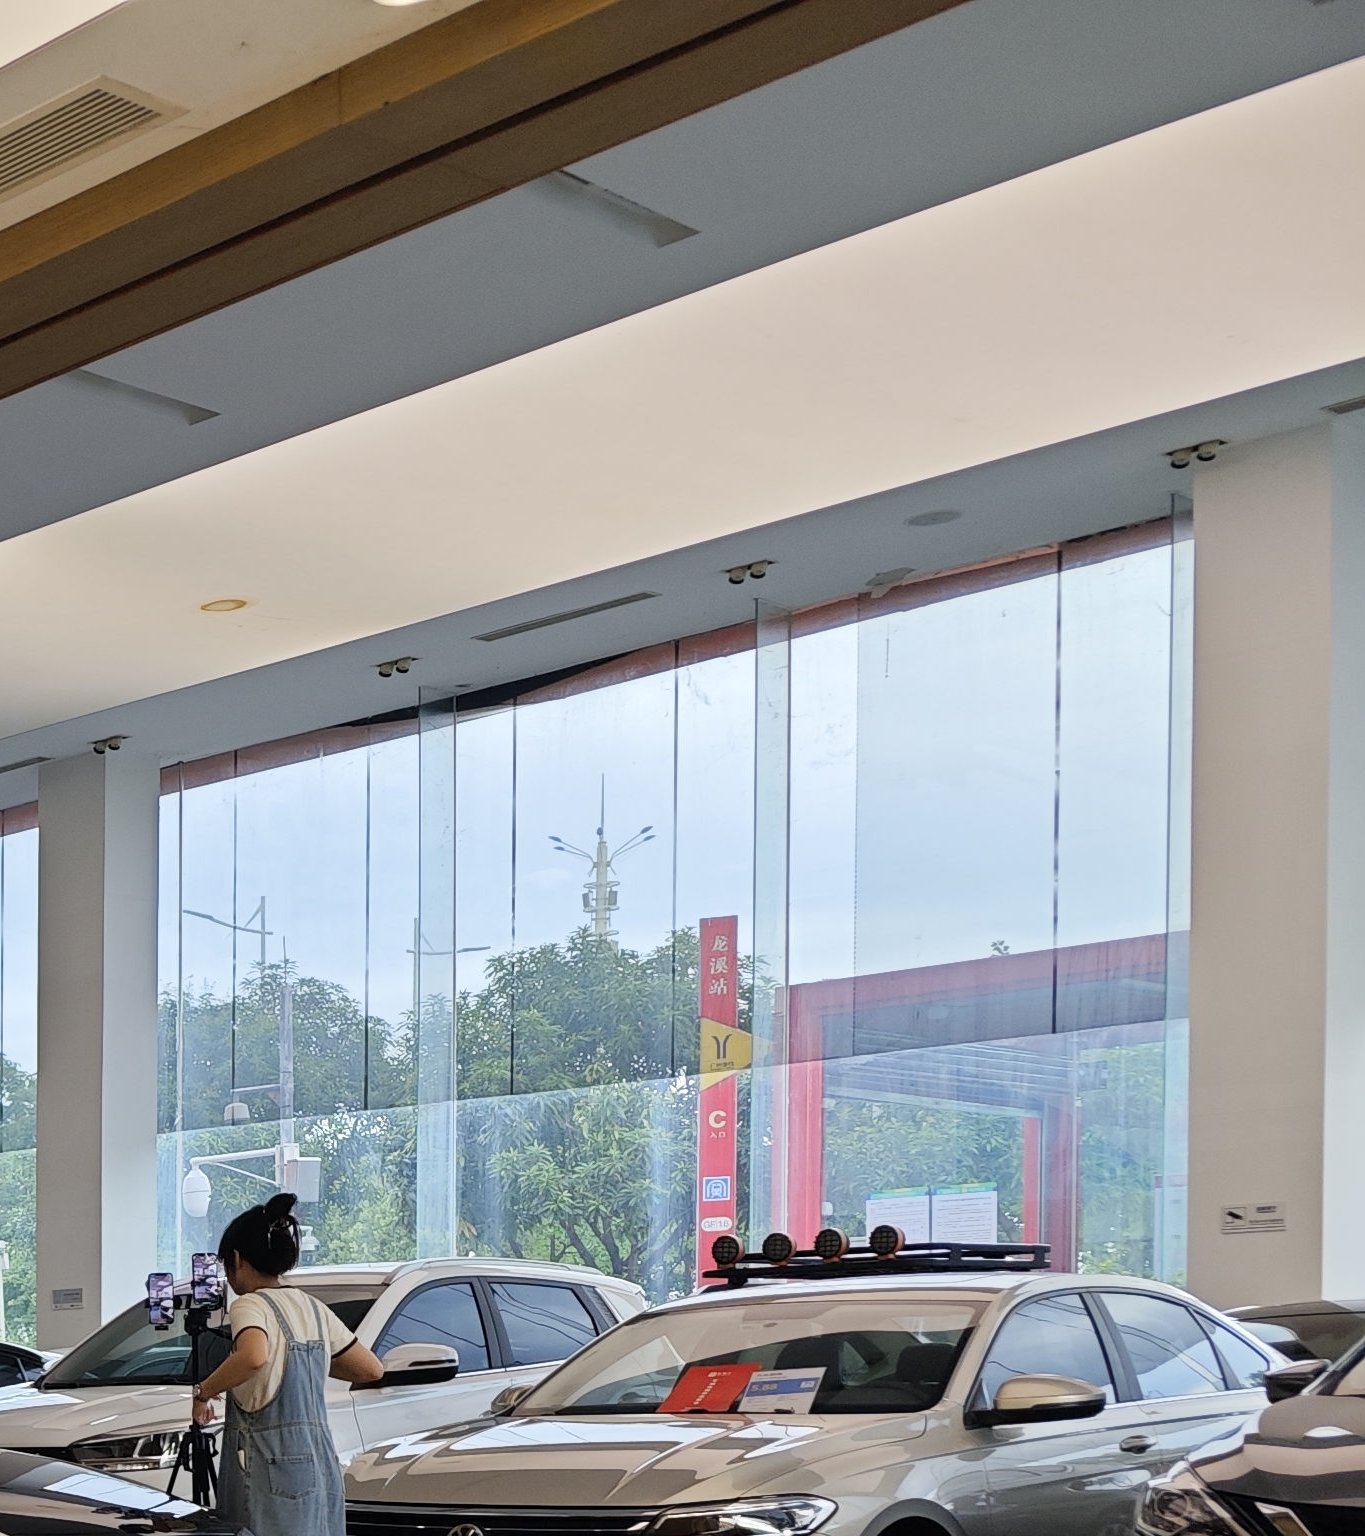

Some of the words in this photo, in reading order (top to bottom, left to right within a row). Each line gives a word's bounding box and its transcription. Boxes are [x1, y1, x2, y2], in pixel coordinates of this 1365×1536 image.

[709, 935, 729, 996] 龙溪站
[708, 1109, 727, 1129] C
[709, 1131, 726, 1139] 入口
